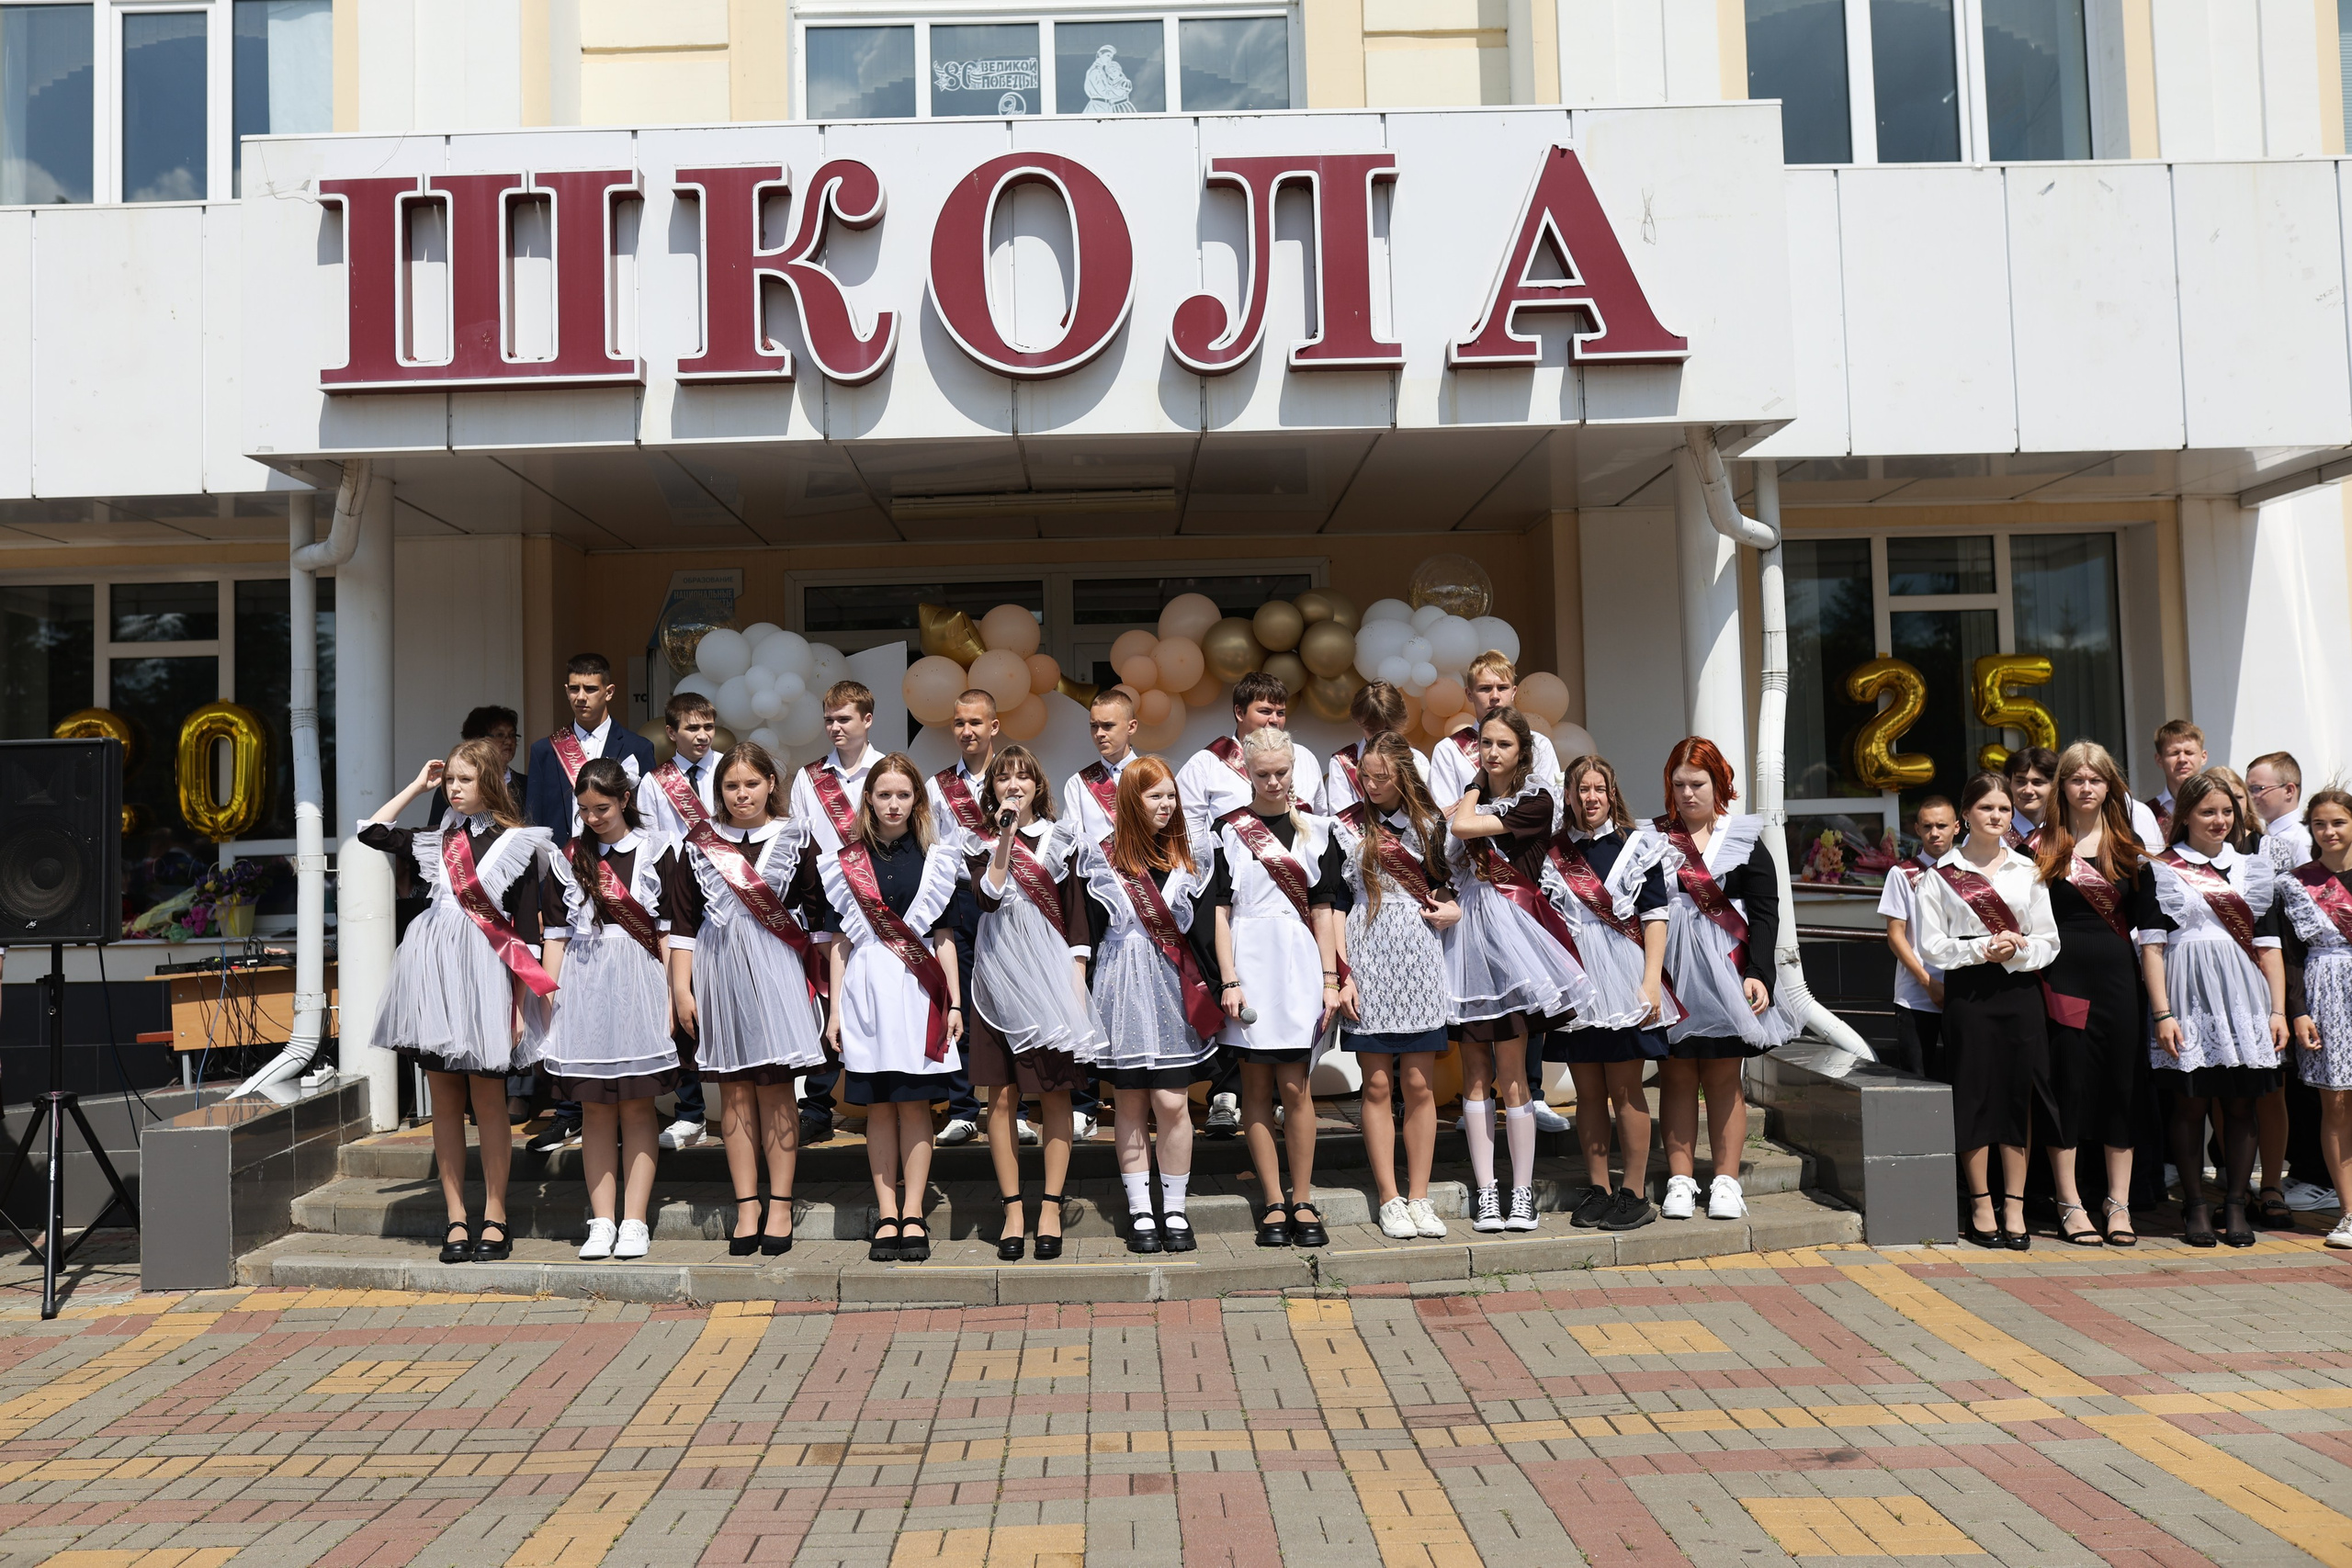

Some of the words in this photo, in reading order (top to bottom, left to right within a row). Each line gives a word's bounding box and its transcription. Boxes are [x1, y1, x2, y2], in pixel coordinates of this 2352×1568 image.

[980, 59, 1037, 72] ВЕЛИКОЙ
[980, 74, 1037, 89] ПОБЕДЫ!
[319, 143, 1690, 395] ШКОЛА
[683, 576, 734, 584] ОБРАЗОВАНИЕ
[673, 589, 733, 600] НАЦИОНАЛЬНЫЕ
[1492, 863, 1516, 886] 2025
[766, 909, 790, 931] 2025
[849, 867, 906, 944] Выпускница
[899, 942, 928, 965] 2025
